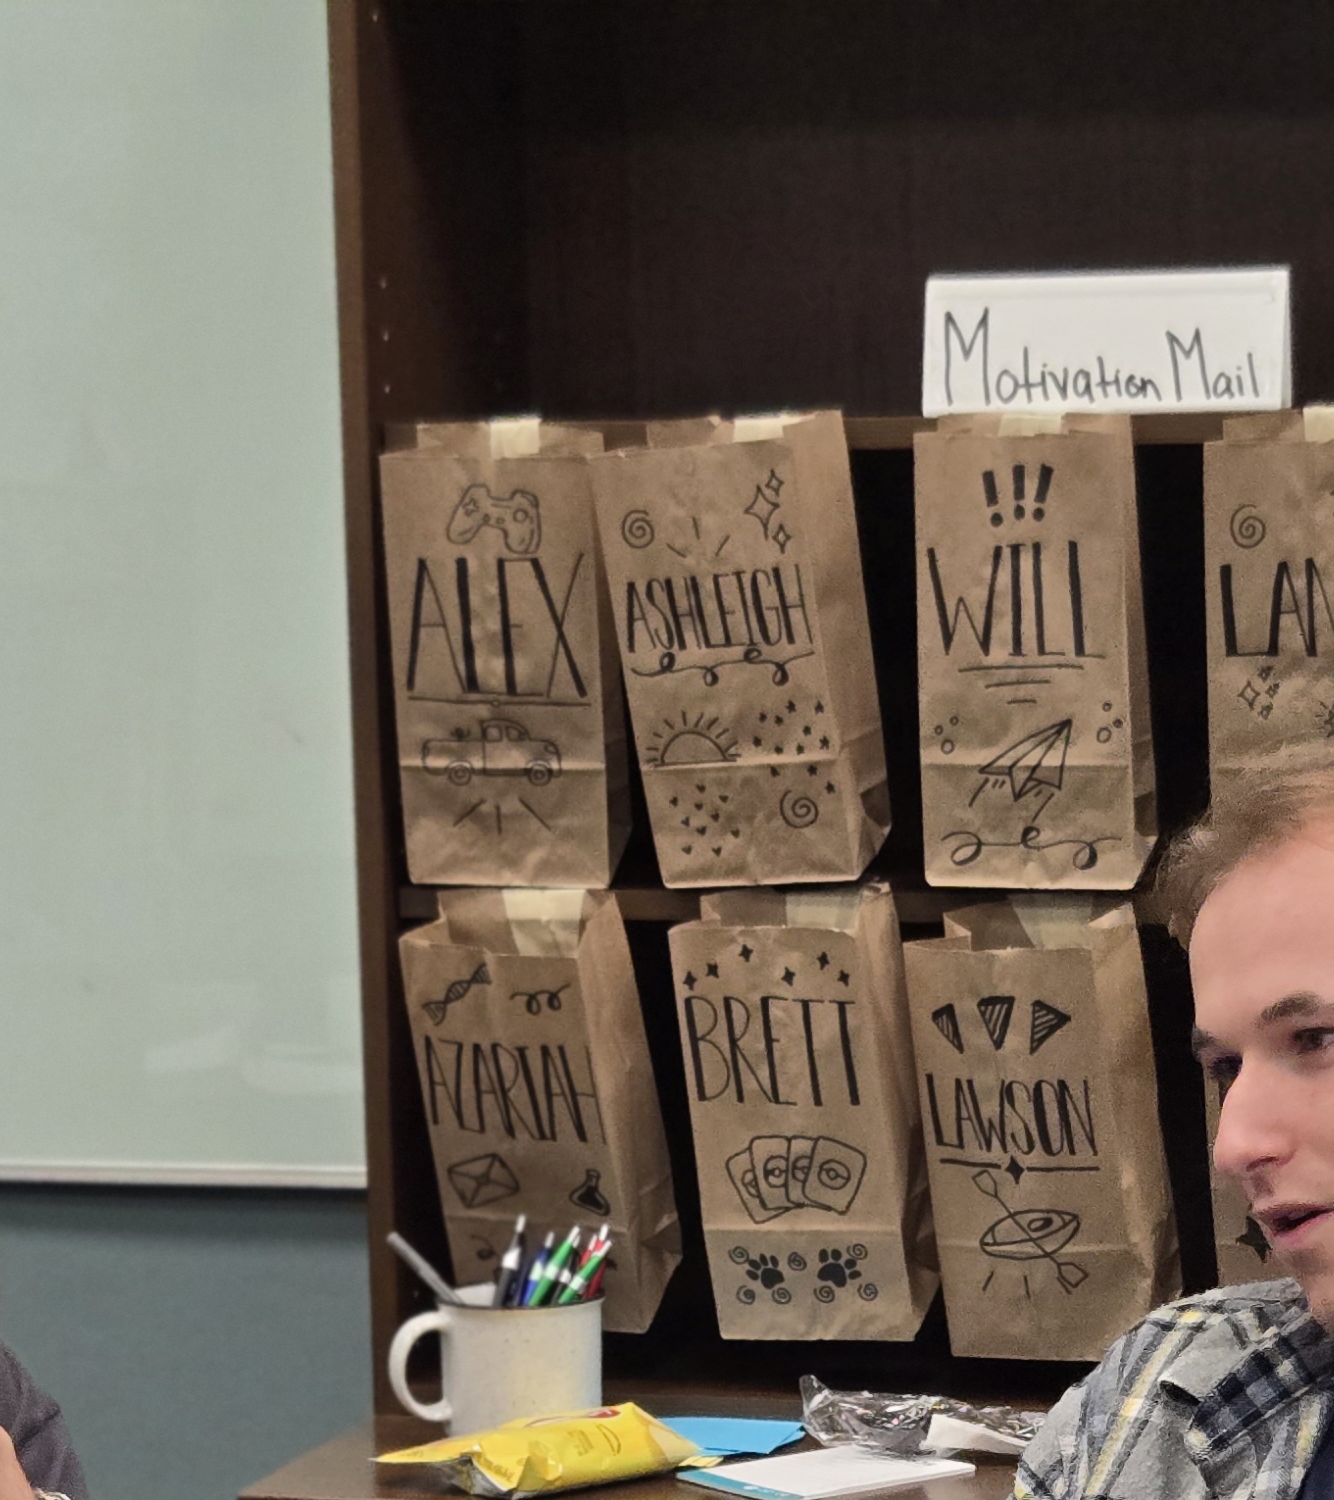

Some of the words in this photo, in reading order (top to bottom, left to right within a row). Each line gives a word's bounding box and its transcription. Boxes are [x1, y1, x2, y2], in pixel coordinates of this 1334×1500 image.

[943, 307, 1163, 407] Motivation
[1165, 328, 1261, 402] Mail
[407, 552, 588, 698] ALEX
[626, 563, 814, 654] ASHLEIGH
[927, 540, 1106, 659] WILL
[424, 1034, 607, 1146] AZARIAH
[684, 995, 862, 1108] BRETT
[926, 1072, 1099, 1159] LAWSON
